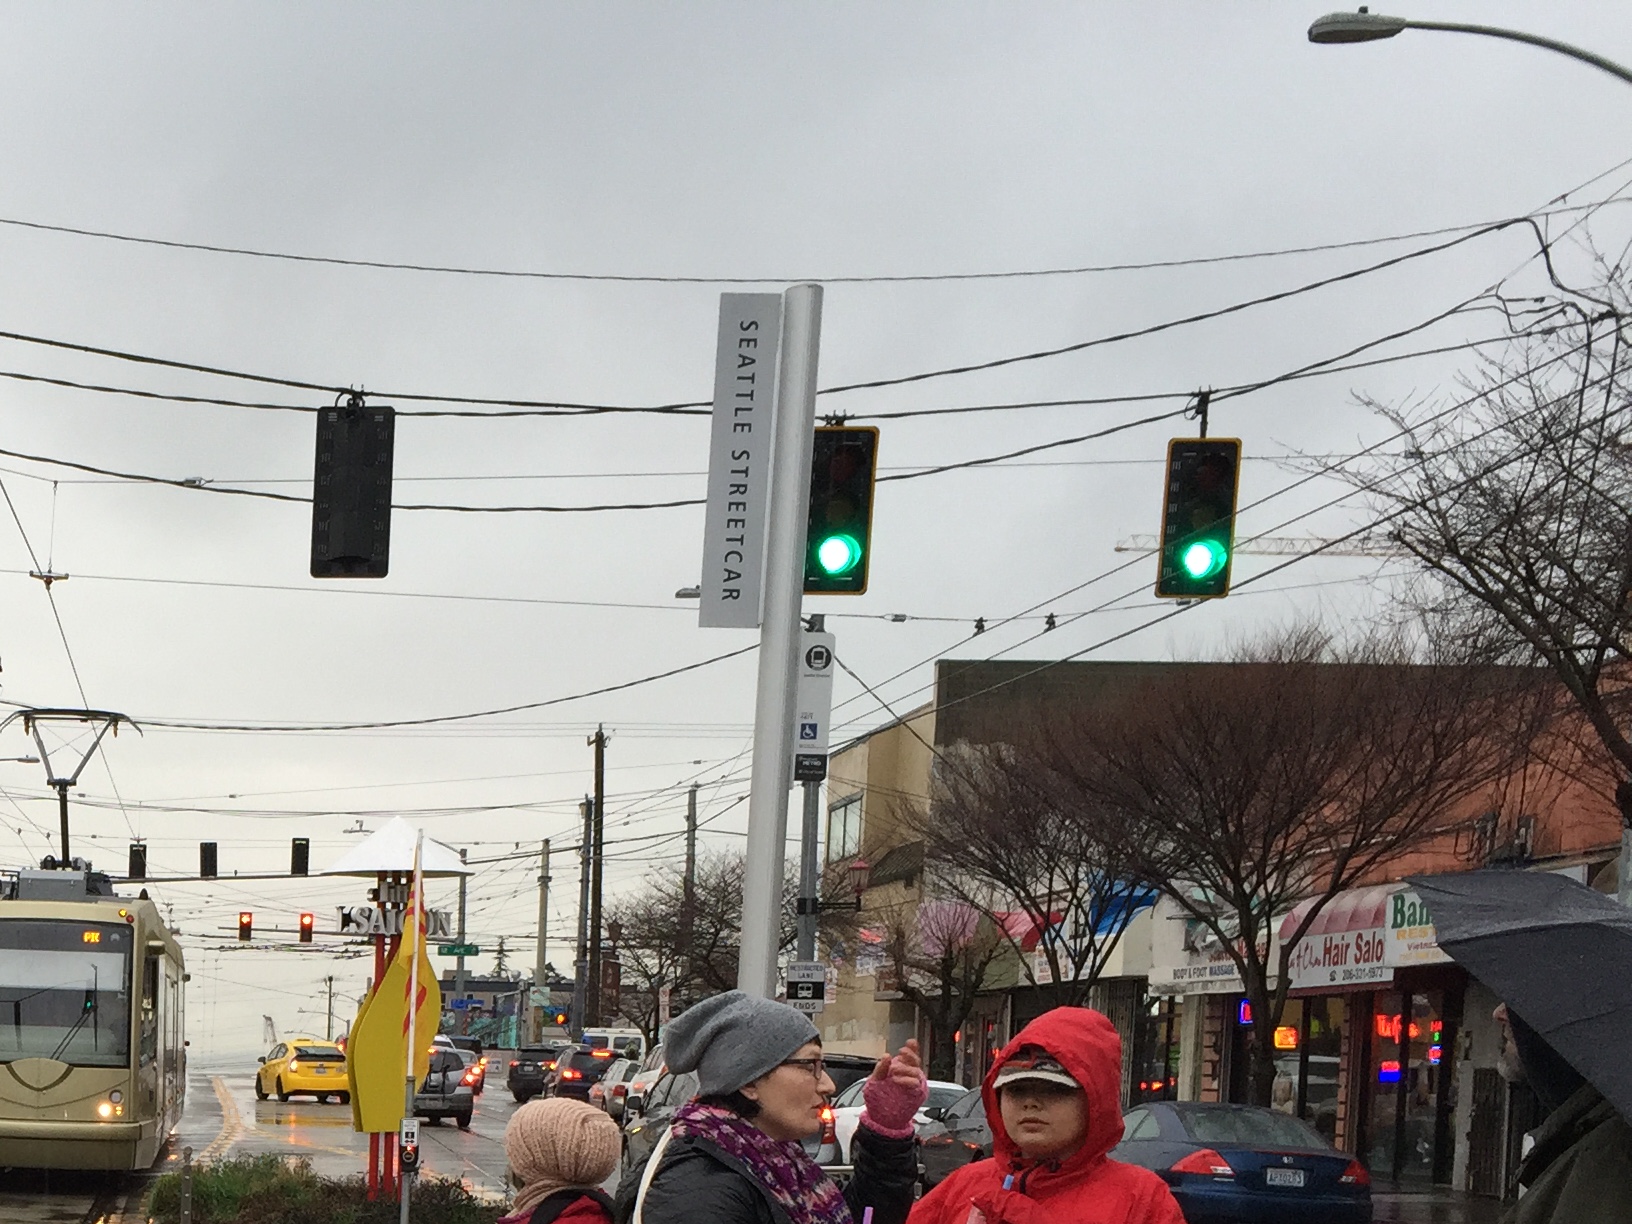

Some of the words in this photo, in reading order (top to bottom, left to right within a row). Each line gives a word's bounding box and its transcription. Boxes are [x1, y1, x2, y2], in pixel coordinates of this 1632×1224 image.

[732, 319, 759, 434] SEATTLE
[721, 449, 750, 601] STREETCAR
[1322, 934, 1350, 967] Hair
[1192, 966, 1208, 979] FOOT
[793, 1002, 817, 1010] ENDS
